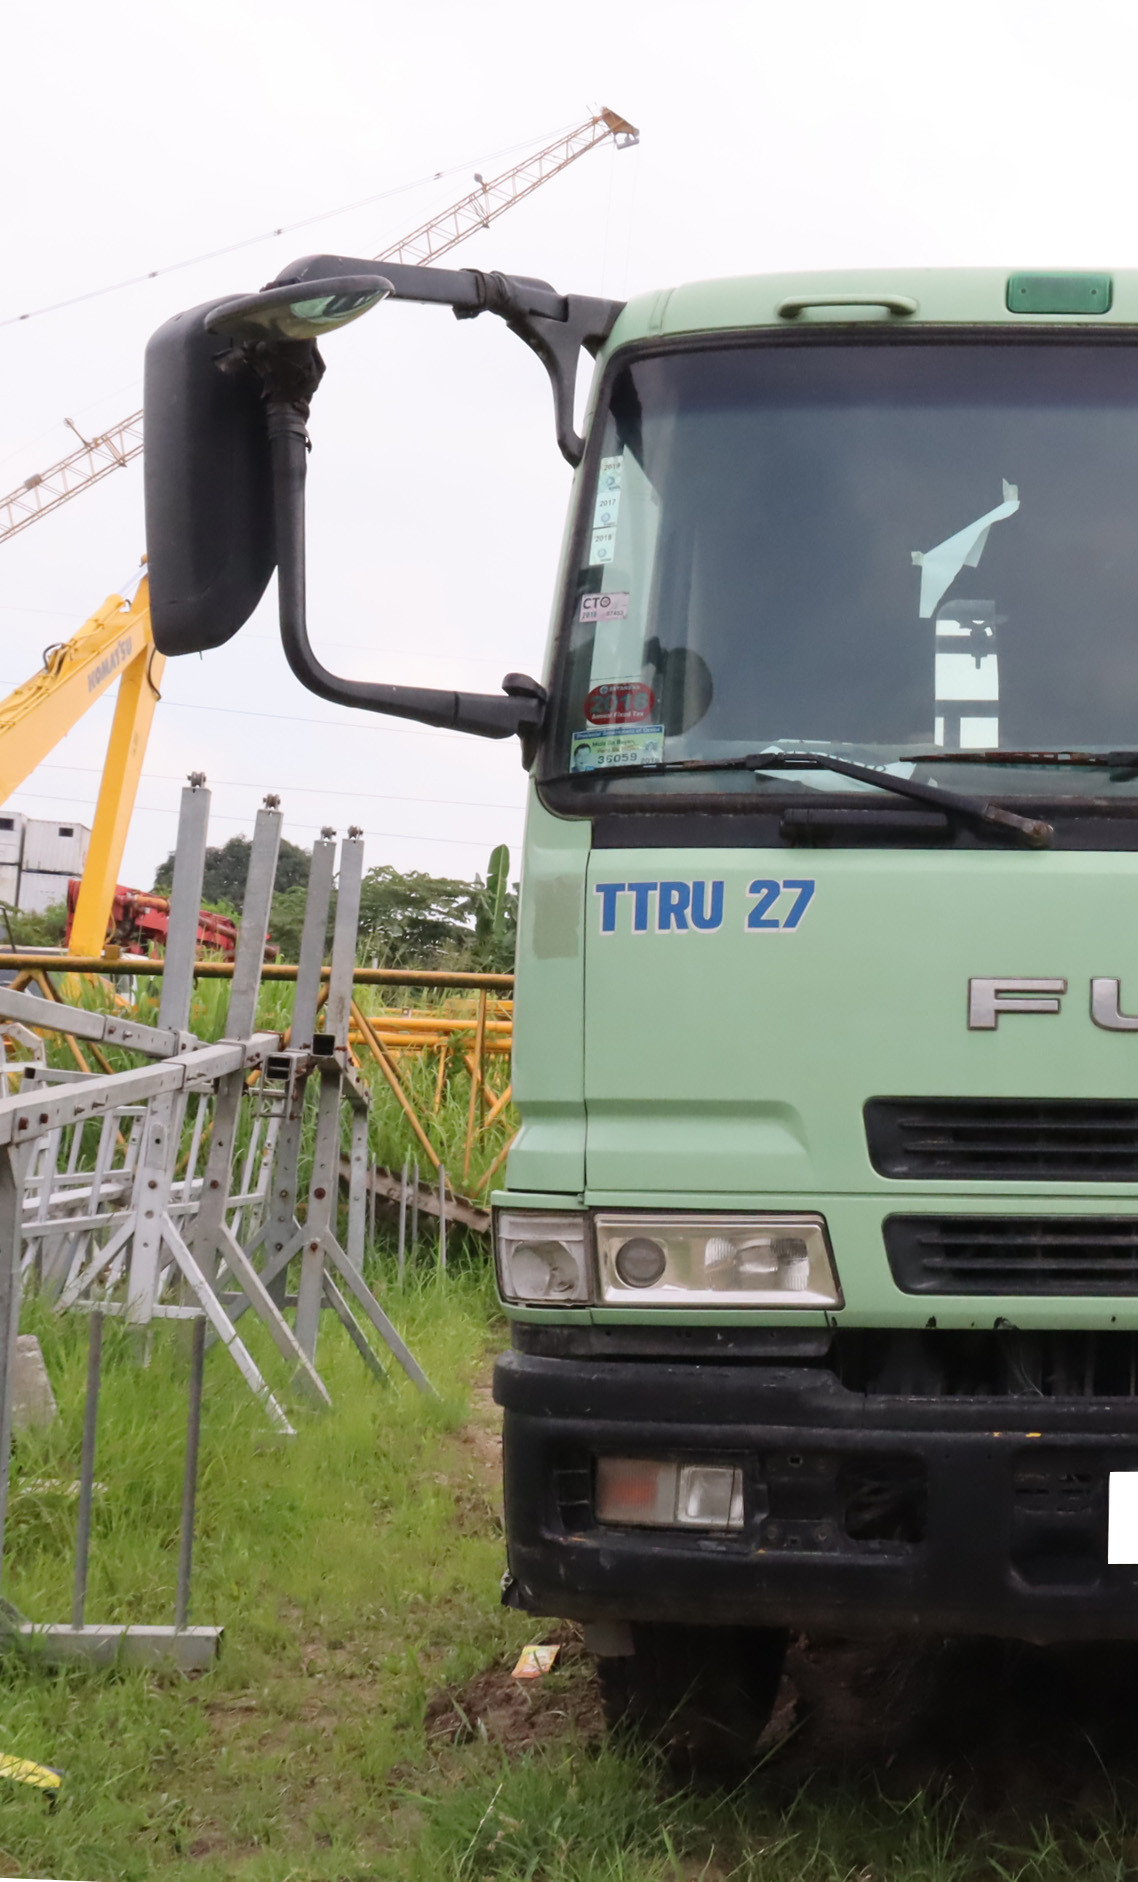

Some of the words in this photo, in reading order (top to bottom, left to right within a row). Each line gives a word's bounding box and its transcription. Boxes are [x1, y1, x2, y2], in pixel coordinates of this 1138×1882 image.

[600, 499, 617, 507] 2017
[582, 596, 612, 610] CTO
[87, 635, 133, 693] KOMATSU
[597, 752, 638, 765] 36059
[594, 881, 725, 934] TTRU
[745, 879, 816, 933] 27
